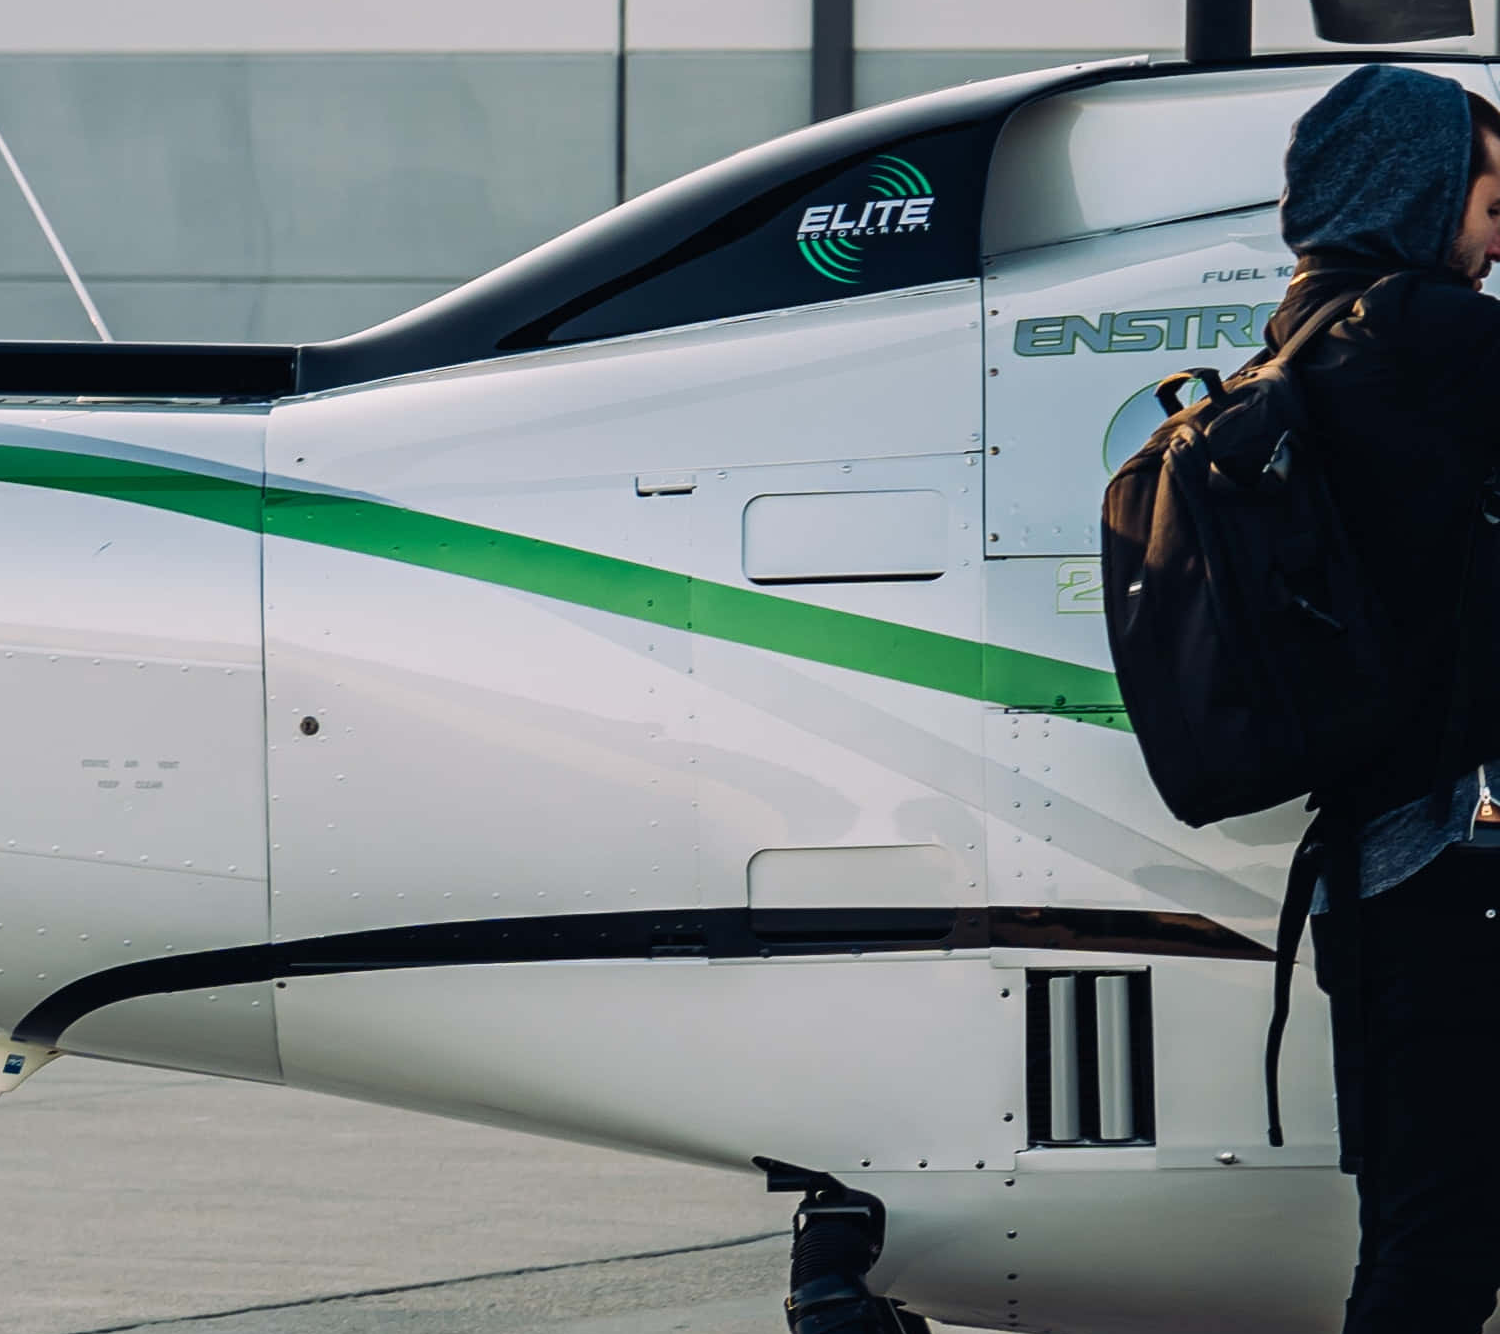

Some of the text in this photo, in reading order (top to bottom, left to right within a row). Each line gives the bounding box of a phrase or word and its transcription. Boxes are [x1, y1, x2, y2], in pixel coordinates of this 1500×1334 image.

[797, 197, 935, 233] ELITE
[796, 223, 931, 241] ROTORCRAFT
[1202, 268, 1267, 284] FUEL
